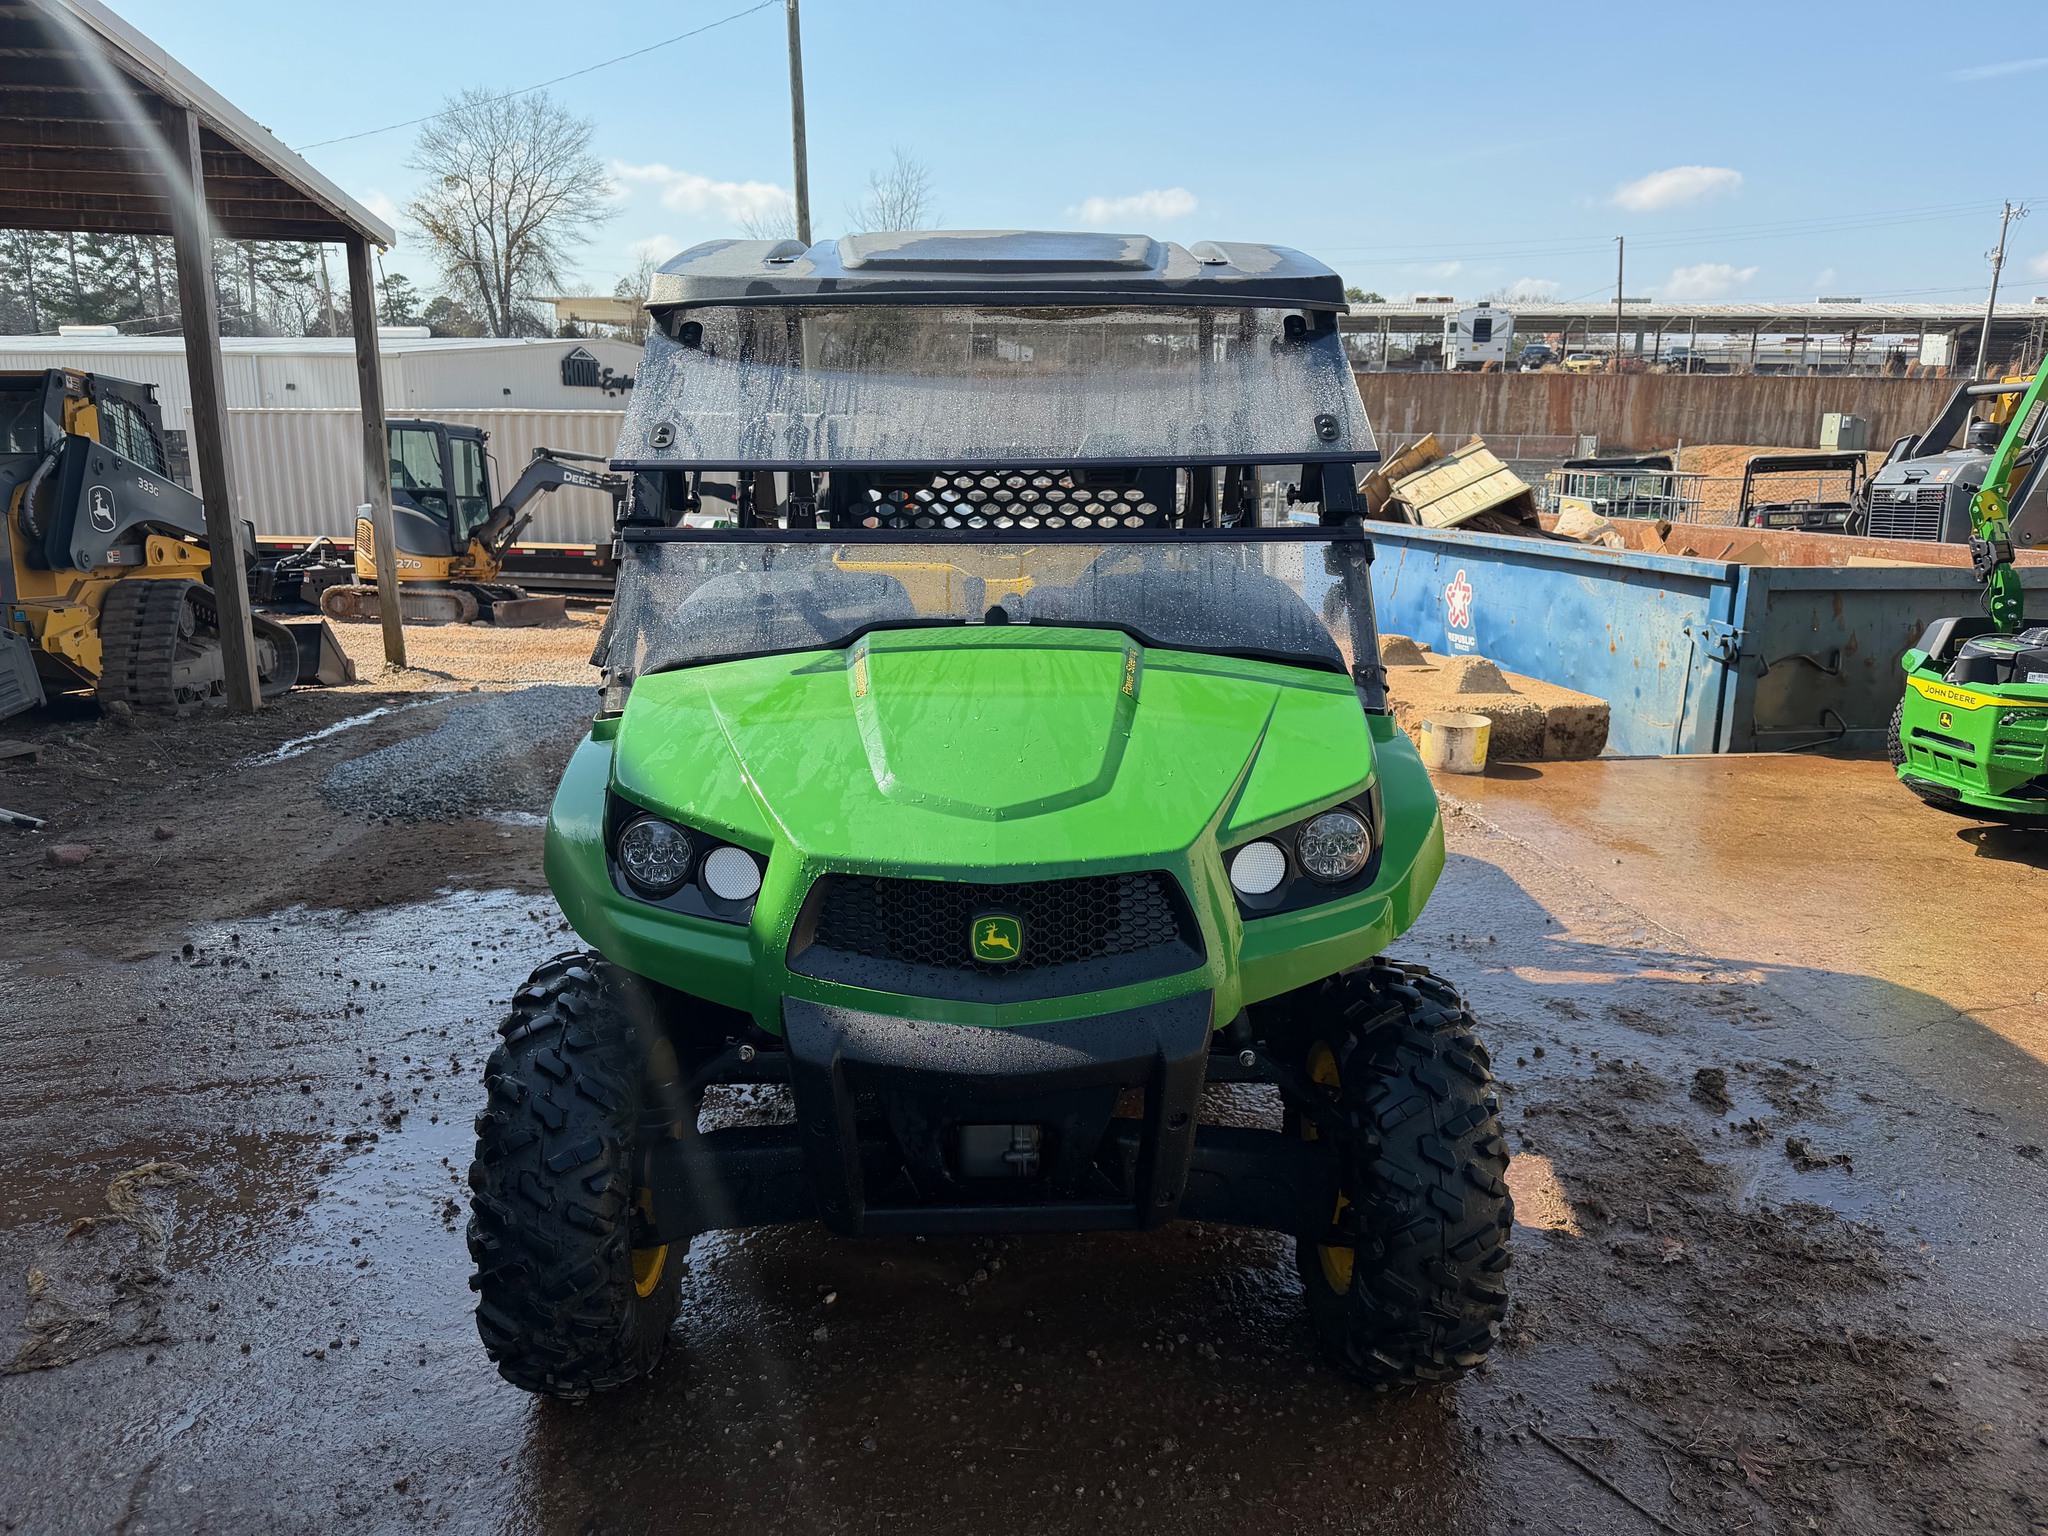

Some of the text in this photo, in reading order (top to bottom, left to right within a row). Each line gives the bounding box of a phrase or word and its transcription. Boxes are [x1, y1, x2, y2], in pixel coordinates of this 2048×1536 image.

[561, 360, 600, 387] HOME
[137, 477, 159, 497] 333G
[396, 558, 422, 569] 27D
[1122, 647, 1138, 696] Power Steering
[1924, 684, 1976, 705] JOHN DEERE
